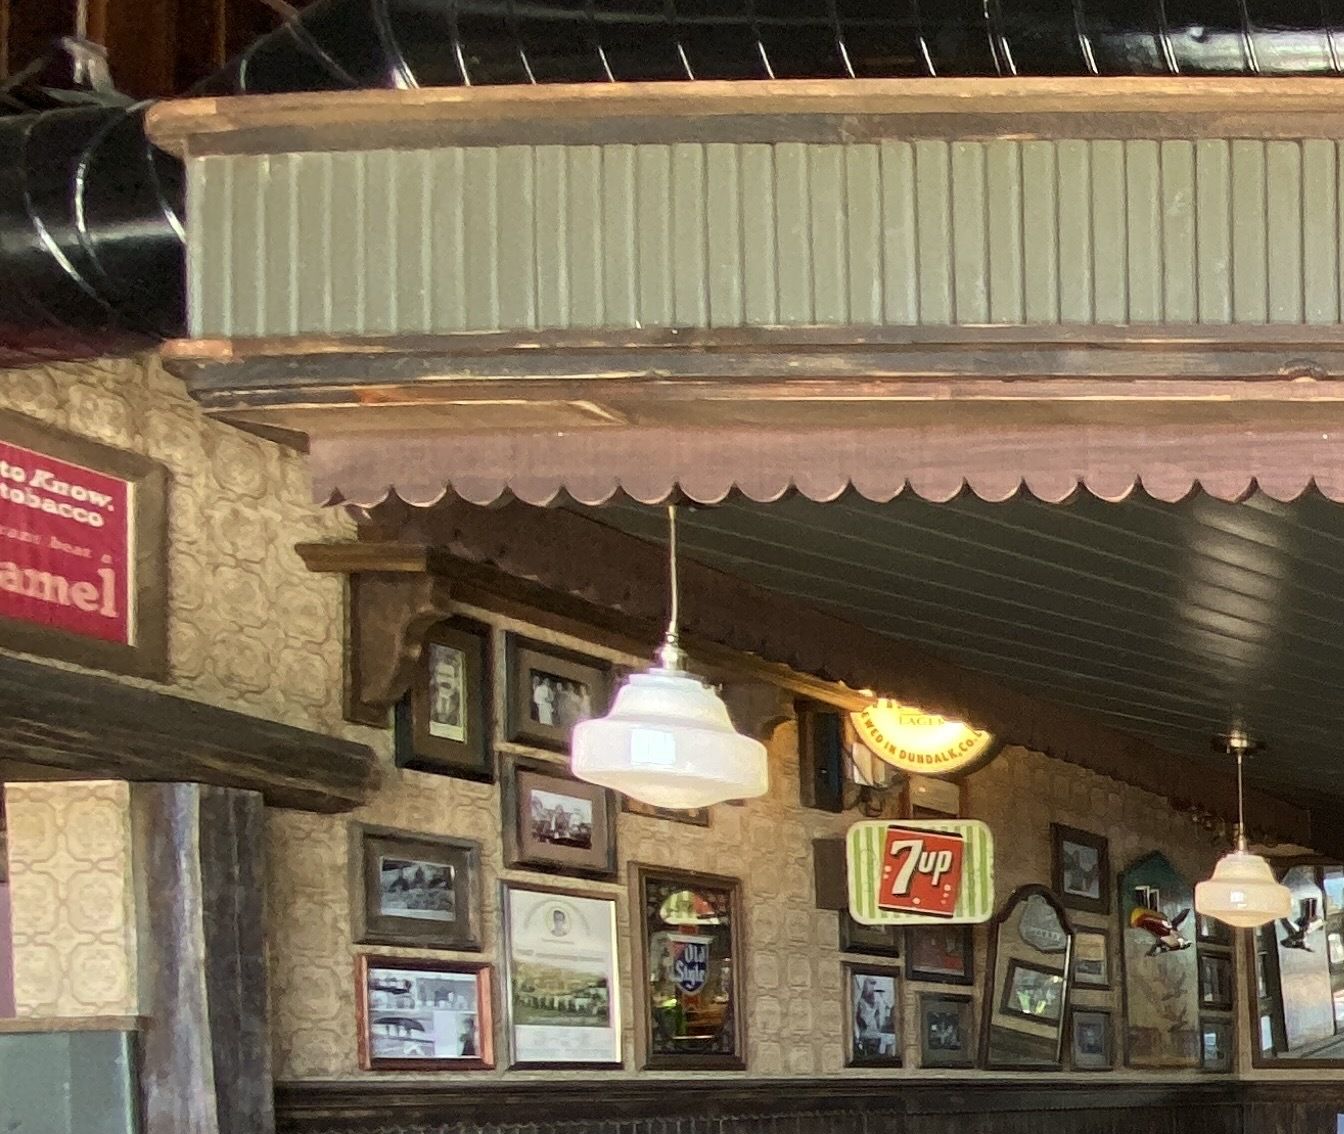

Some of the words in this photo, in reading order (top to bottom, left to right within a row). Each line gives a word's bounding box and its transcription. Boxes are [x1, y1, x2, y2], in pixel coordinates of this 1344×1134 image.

[0, 482, 104, 528] tobacco
[29, 468, 114, 512] Know.
[884, 743, 896, 755] IN
[684, 944, 706, 963] Old
